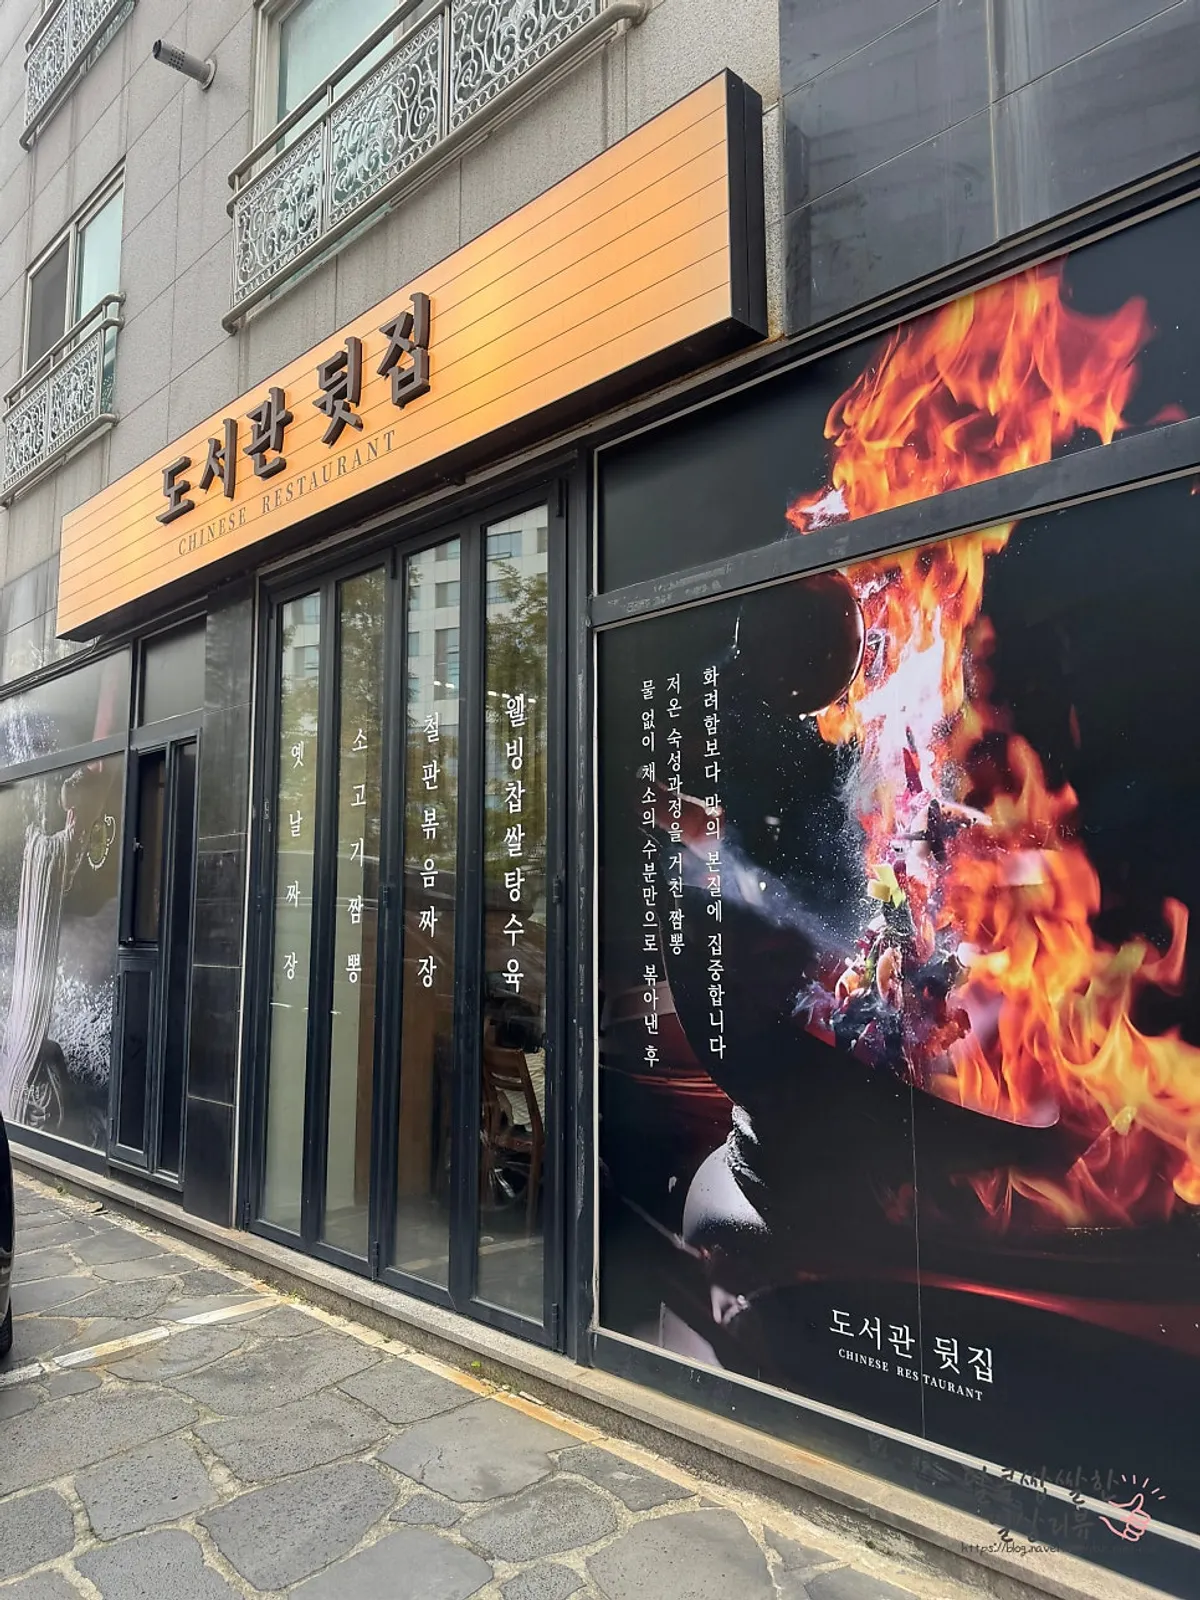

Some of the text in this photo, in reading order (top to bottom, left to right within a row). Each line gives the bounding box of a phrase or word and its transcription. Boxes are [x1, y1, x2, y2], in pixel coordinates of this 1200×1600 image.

[156, 292, 432, 524] 도서관 뒷집
[178, 429, 396, 556] CHINESE RESTAURANT
[282, 740, 305, 981] 옛날짜장
[345, 727, 368, 984] 소고기짬뽕
[417, 712, 441, 989] 철판볶음짜장
[501, 693, 526, 994] 웰빙찹쌀탕수육
[640, 679, 660, 1068] 물 없이 채소의 수분만으로 볶아낸 후
[666, 672, 685, 956] 저온 숙성과정을 거친 짬뽕
[702, 665, 727, 1060] 화려함보다 맛의 본질에 집중합니다
[829, 1309, 994, 1384] 도서관 뒷집
[838, 1347, 983, 1402] CHINESE RESTAURANT
